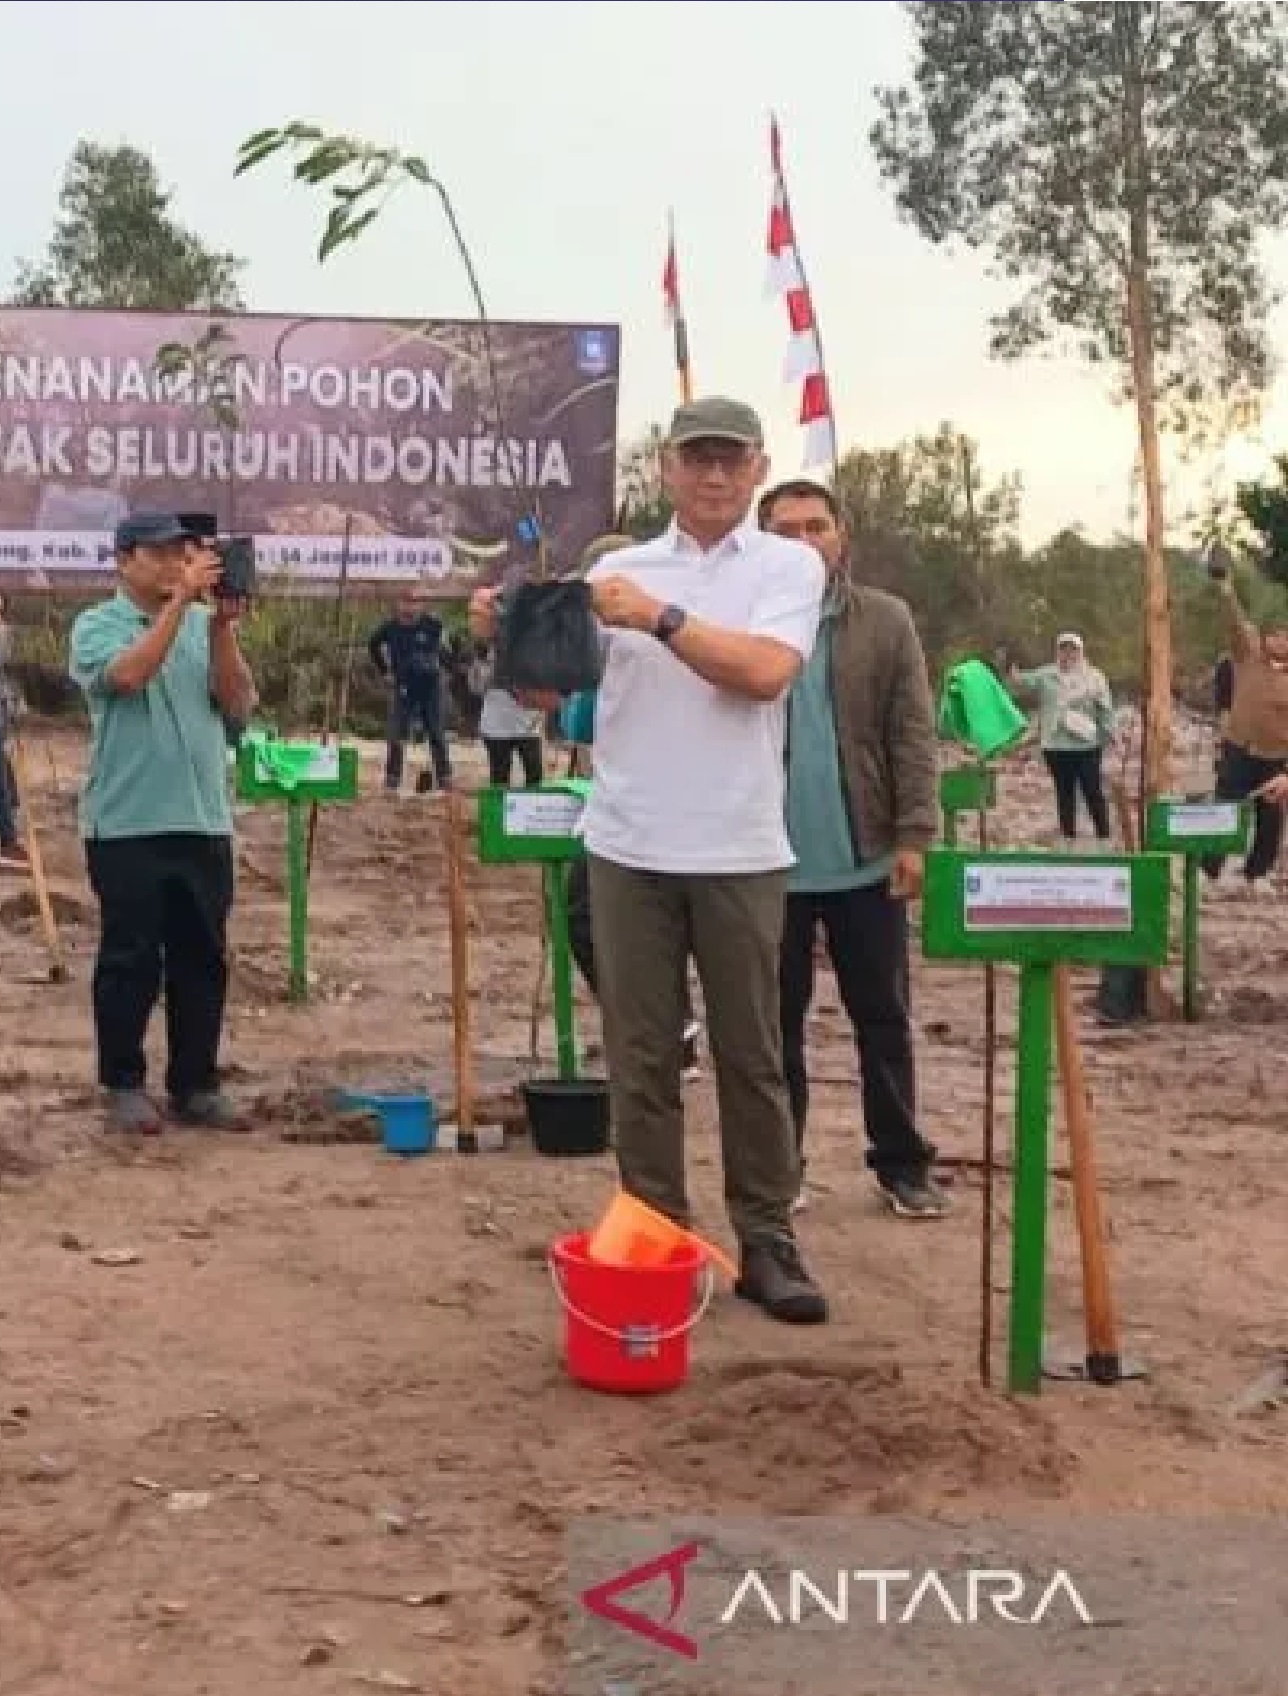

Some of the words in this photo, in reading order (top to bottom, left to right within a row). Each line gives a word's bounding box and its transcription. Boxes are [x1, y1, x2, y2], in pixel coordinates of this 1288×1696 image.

[283, 366, 453, 412] POHON
[87, 427, 298, 480] SELURUH
[313, 434, 571, 487] INDONESIA
